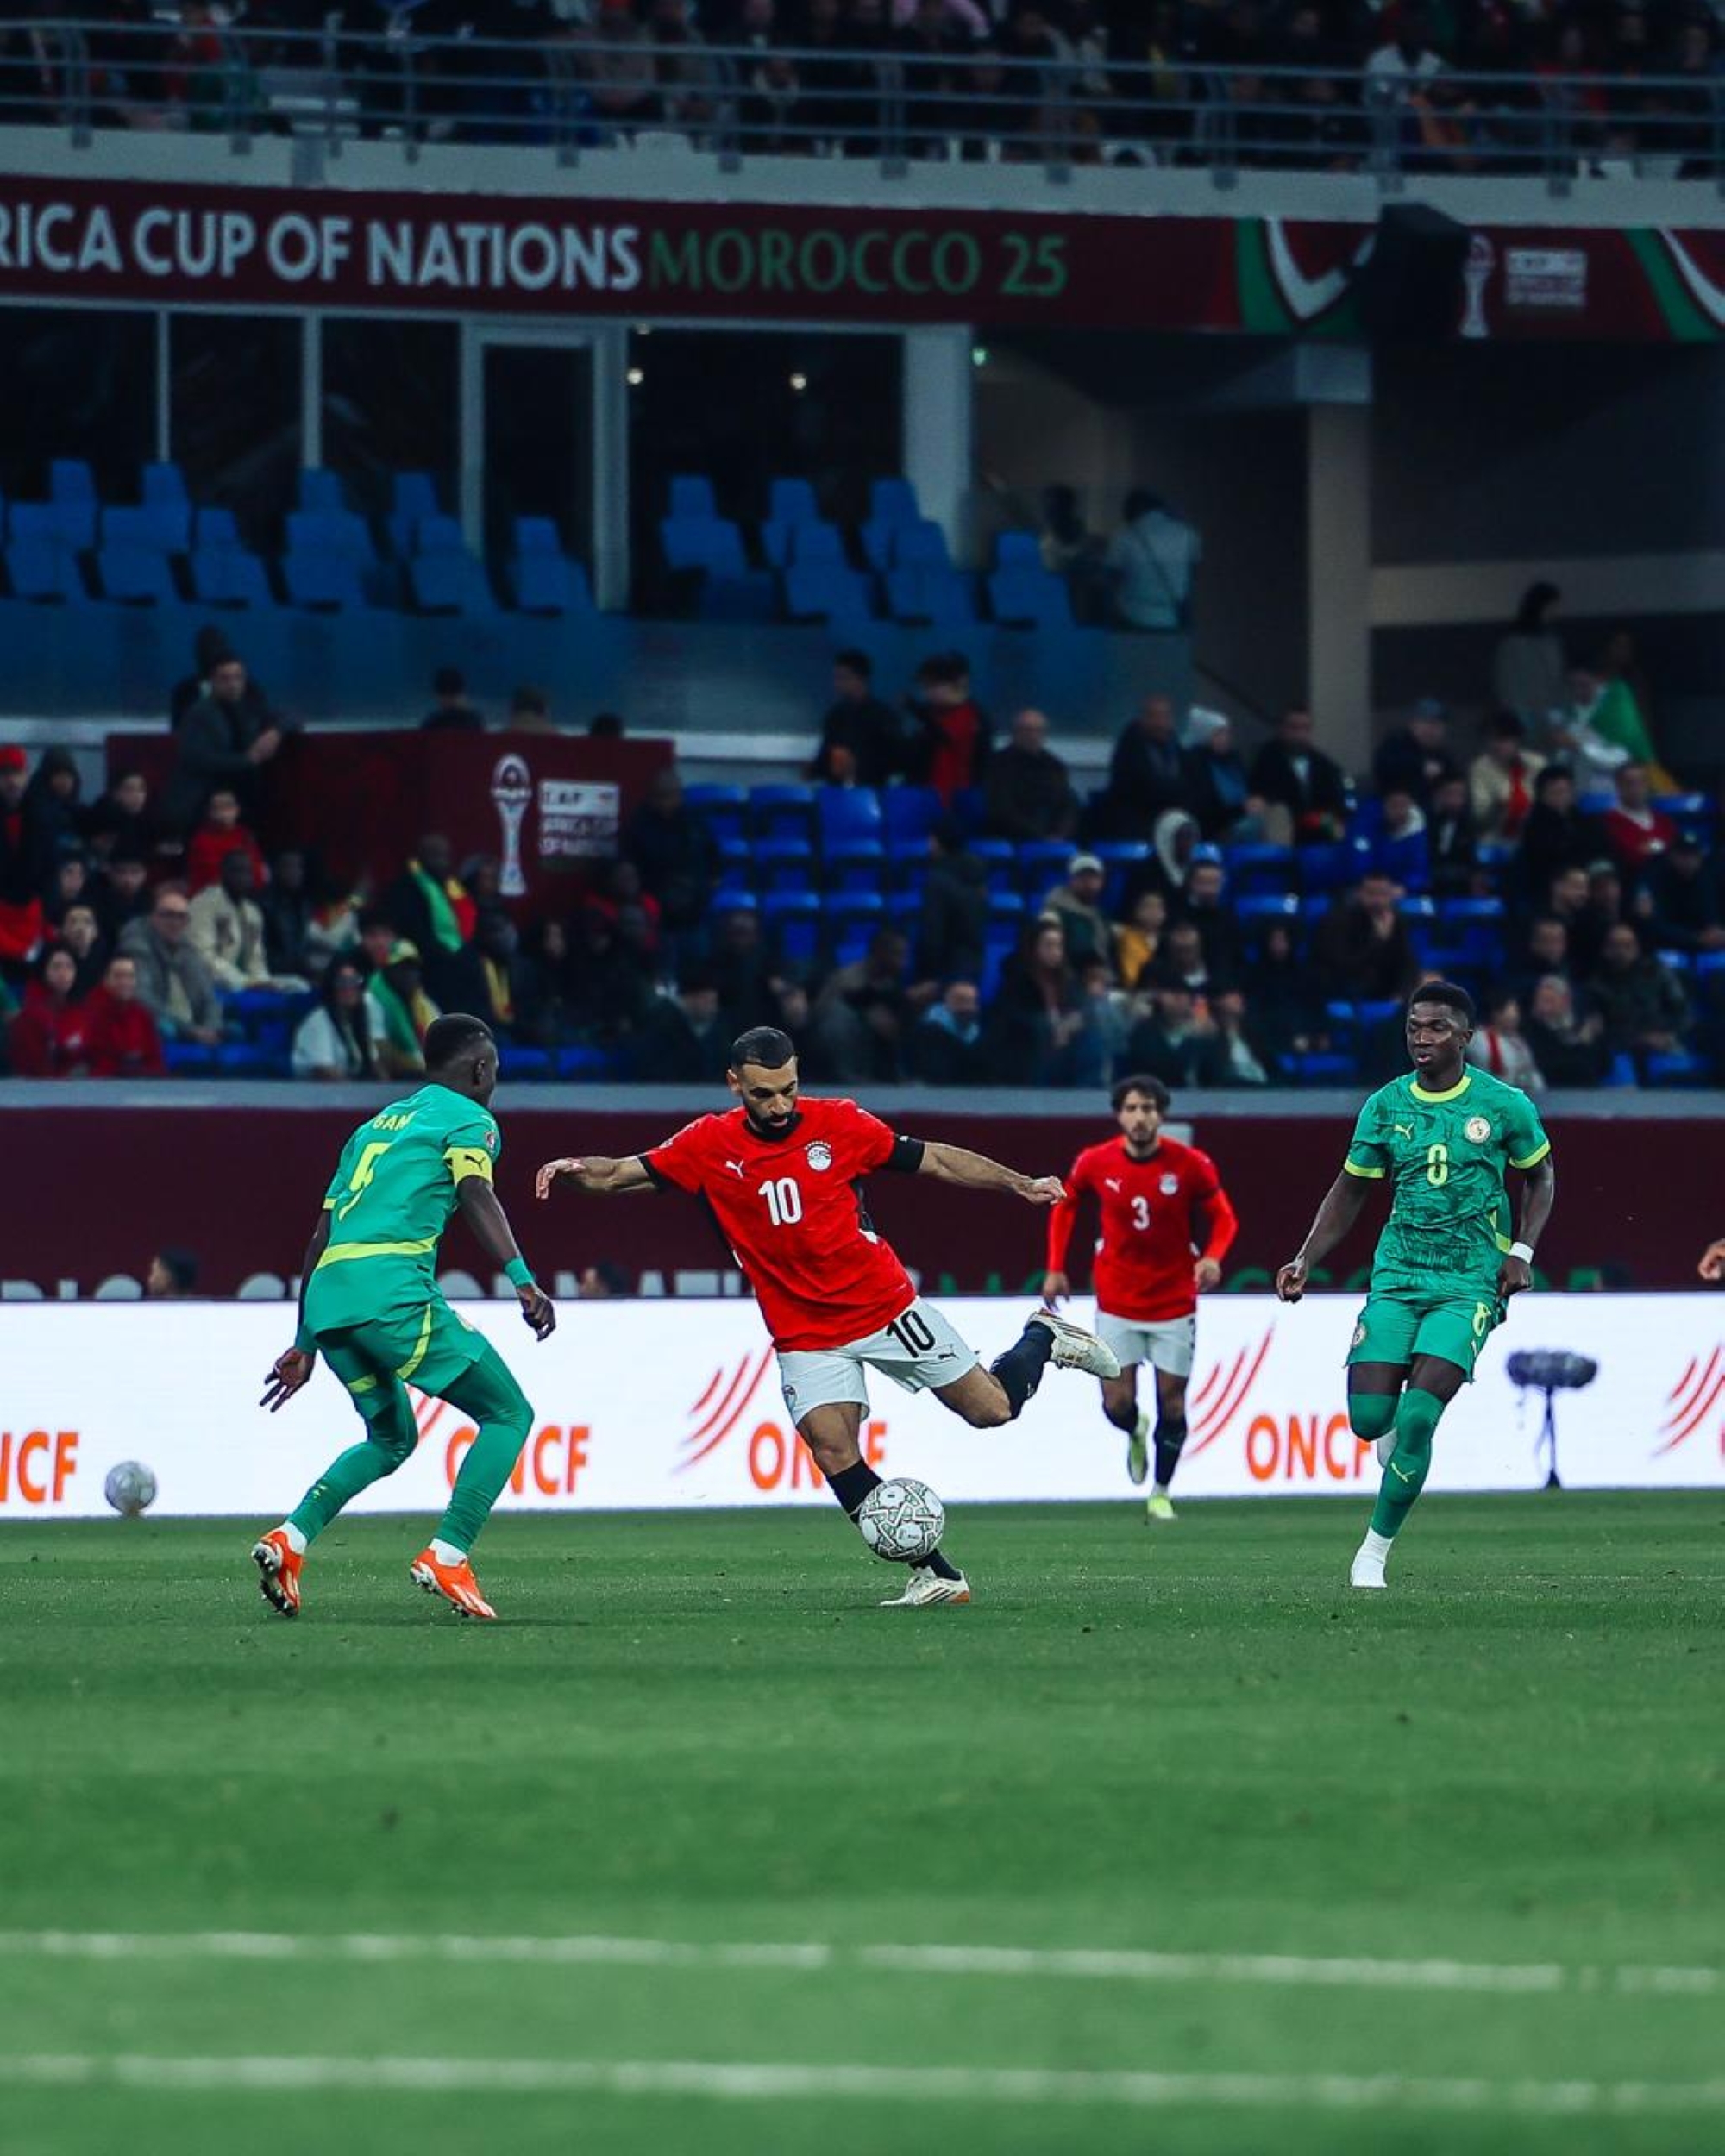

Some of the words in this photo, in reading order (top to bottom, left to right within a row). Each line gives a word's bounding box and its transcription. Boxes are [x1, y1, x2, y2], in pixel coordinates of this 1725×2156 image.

[134, 206, 255, 278] CUP
[267, 213, 351, 282] OF
[367, 221, 641, 291] NATIONS
[650, 228, 981, 293] MOROCCO
[1000, 234, 1068, 296] 25
[757, 1176, 803, 1226] 10
[1131, 1195, 1150, 1230] 3
[886, 1309, 936, 1358] 10
[749, 1421, 888, 1490] ONF
